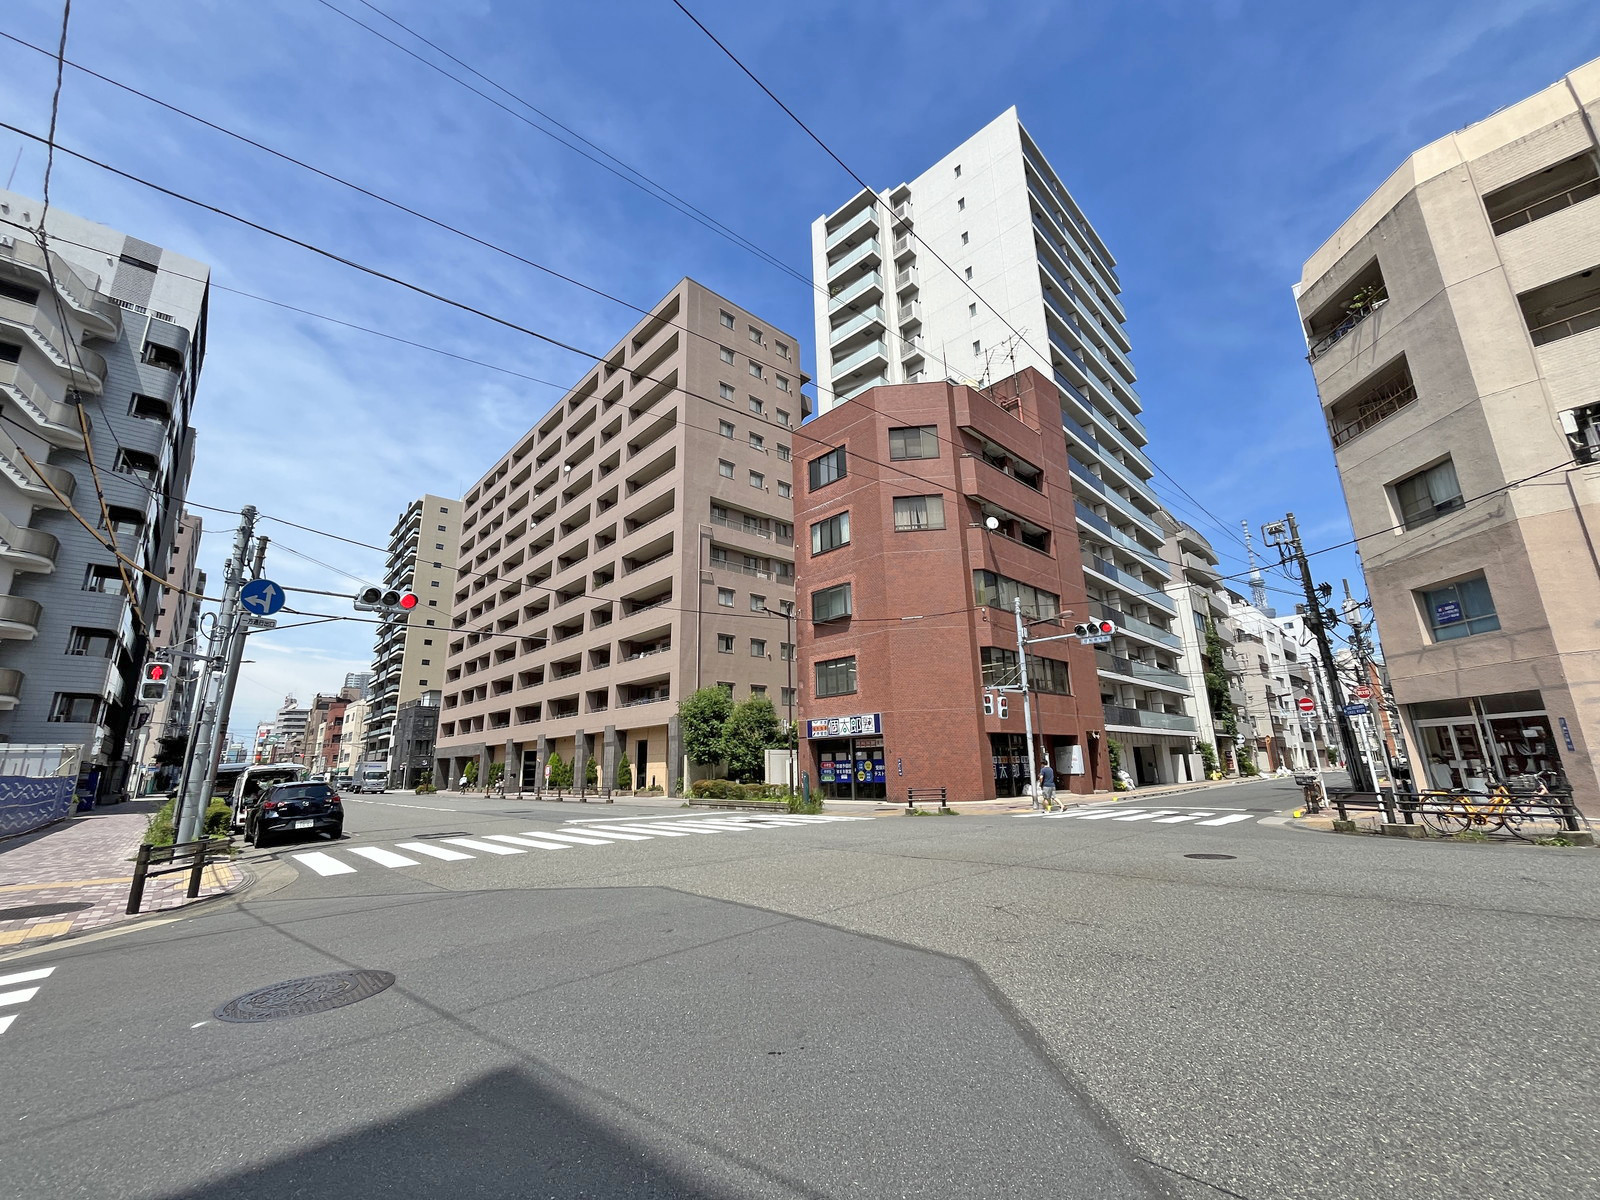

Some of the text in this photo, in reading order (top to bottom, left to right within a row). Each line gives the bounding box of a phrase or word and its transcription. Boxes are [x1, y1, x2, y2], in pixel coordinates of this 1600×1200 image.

[242, 618, 275, 627] 一方通行出口
[828, 717, 874, 735] 個太郎塾
